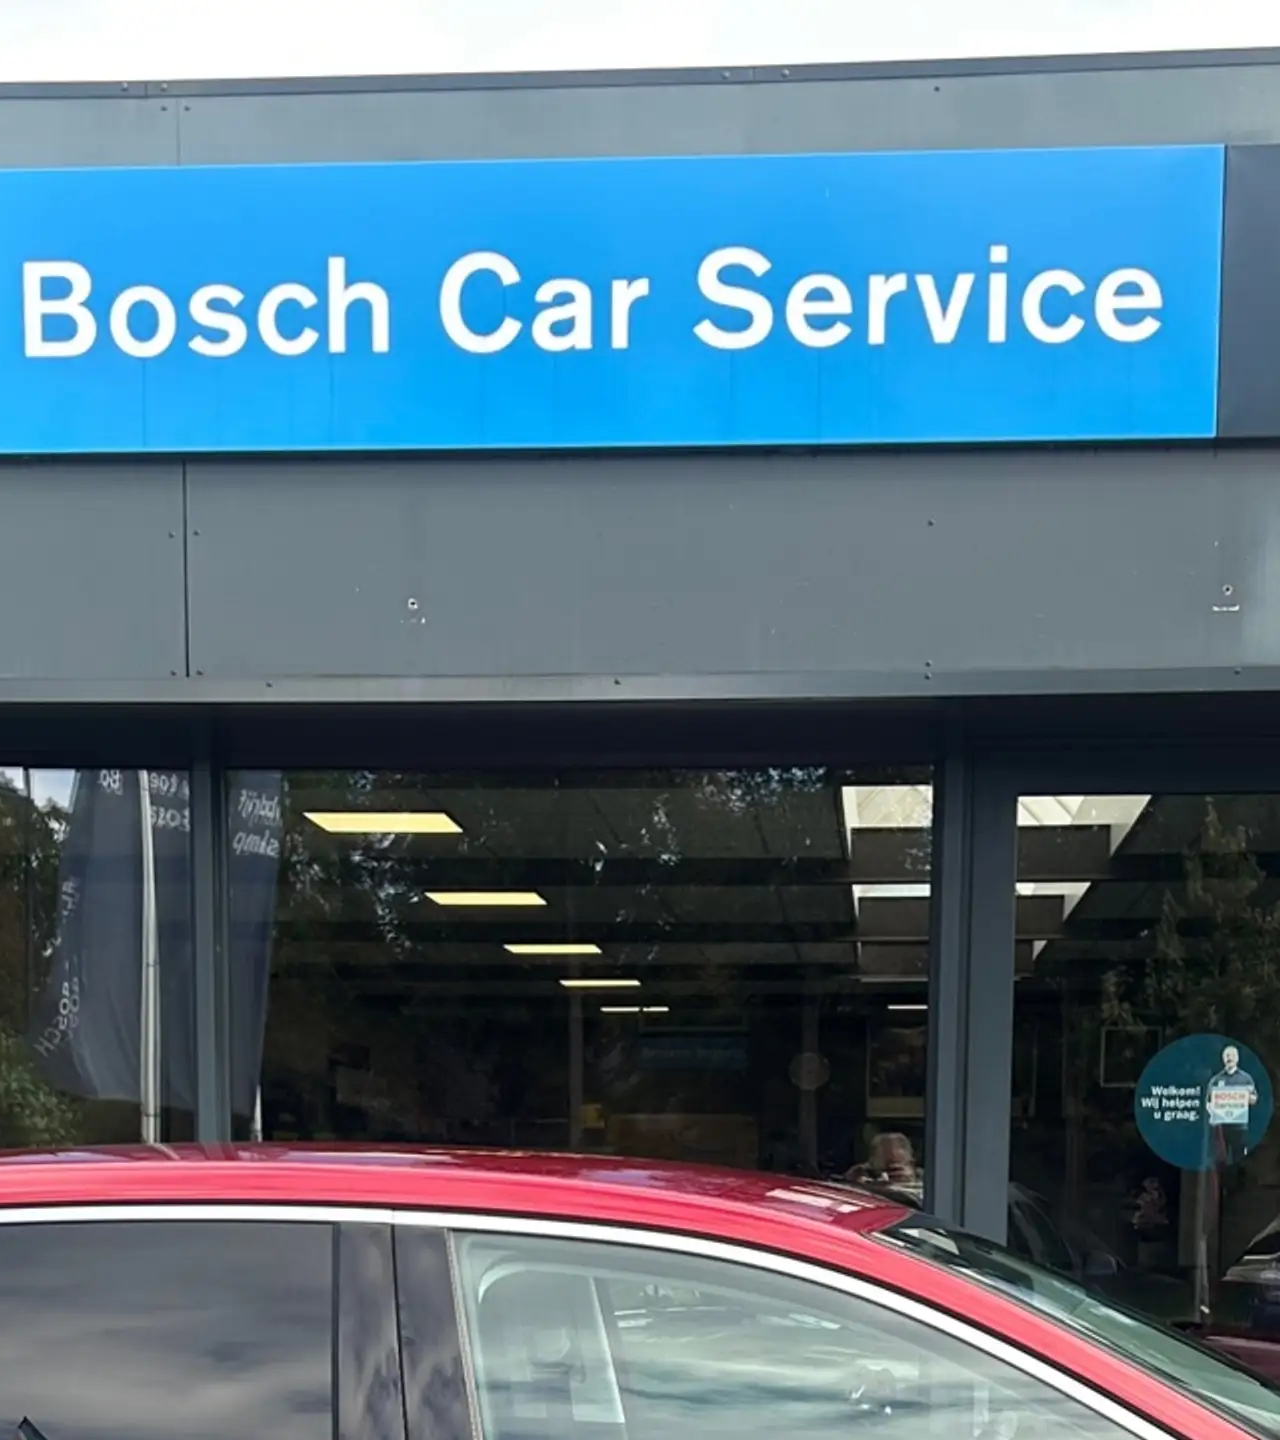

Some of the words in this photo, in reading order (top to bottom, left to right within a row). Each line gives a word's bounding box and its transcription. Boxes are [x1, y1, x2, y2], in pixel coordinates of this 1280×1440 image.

[21, 254, 389, 358] Bosch
[438, 249, 650, 354] Car
[692, 244, 1164, 351] Service
[1151, 1085, 1201, 1097] Welkom!
[1141, 1097, 1160, 1109] Wij
[1162, 1097, 1200, 1109] helpen
[1153, 1111, 1162, 1120] u
[1164, 1110, 1200, 1122] graag.
